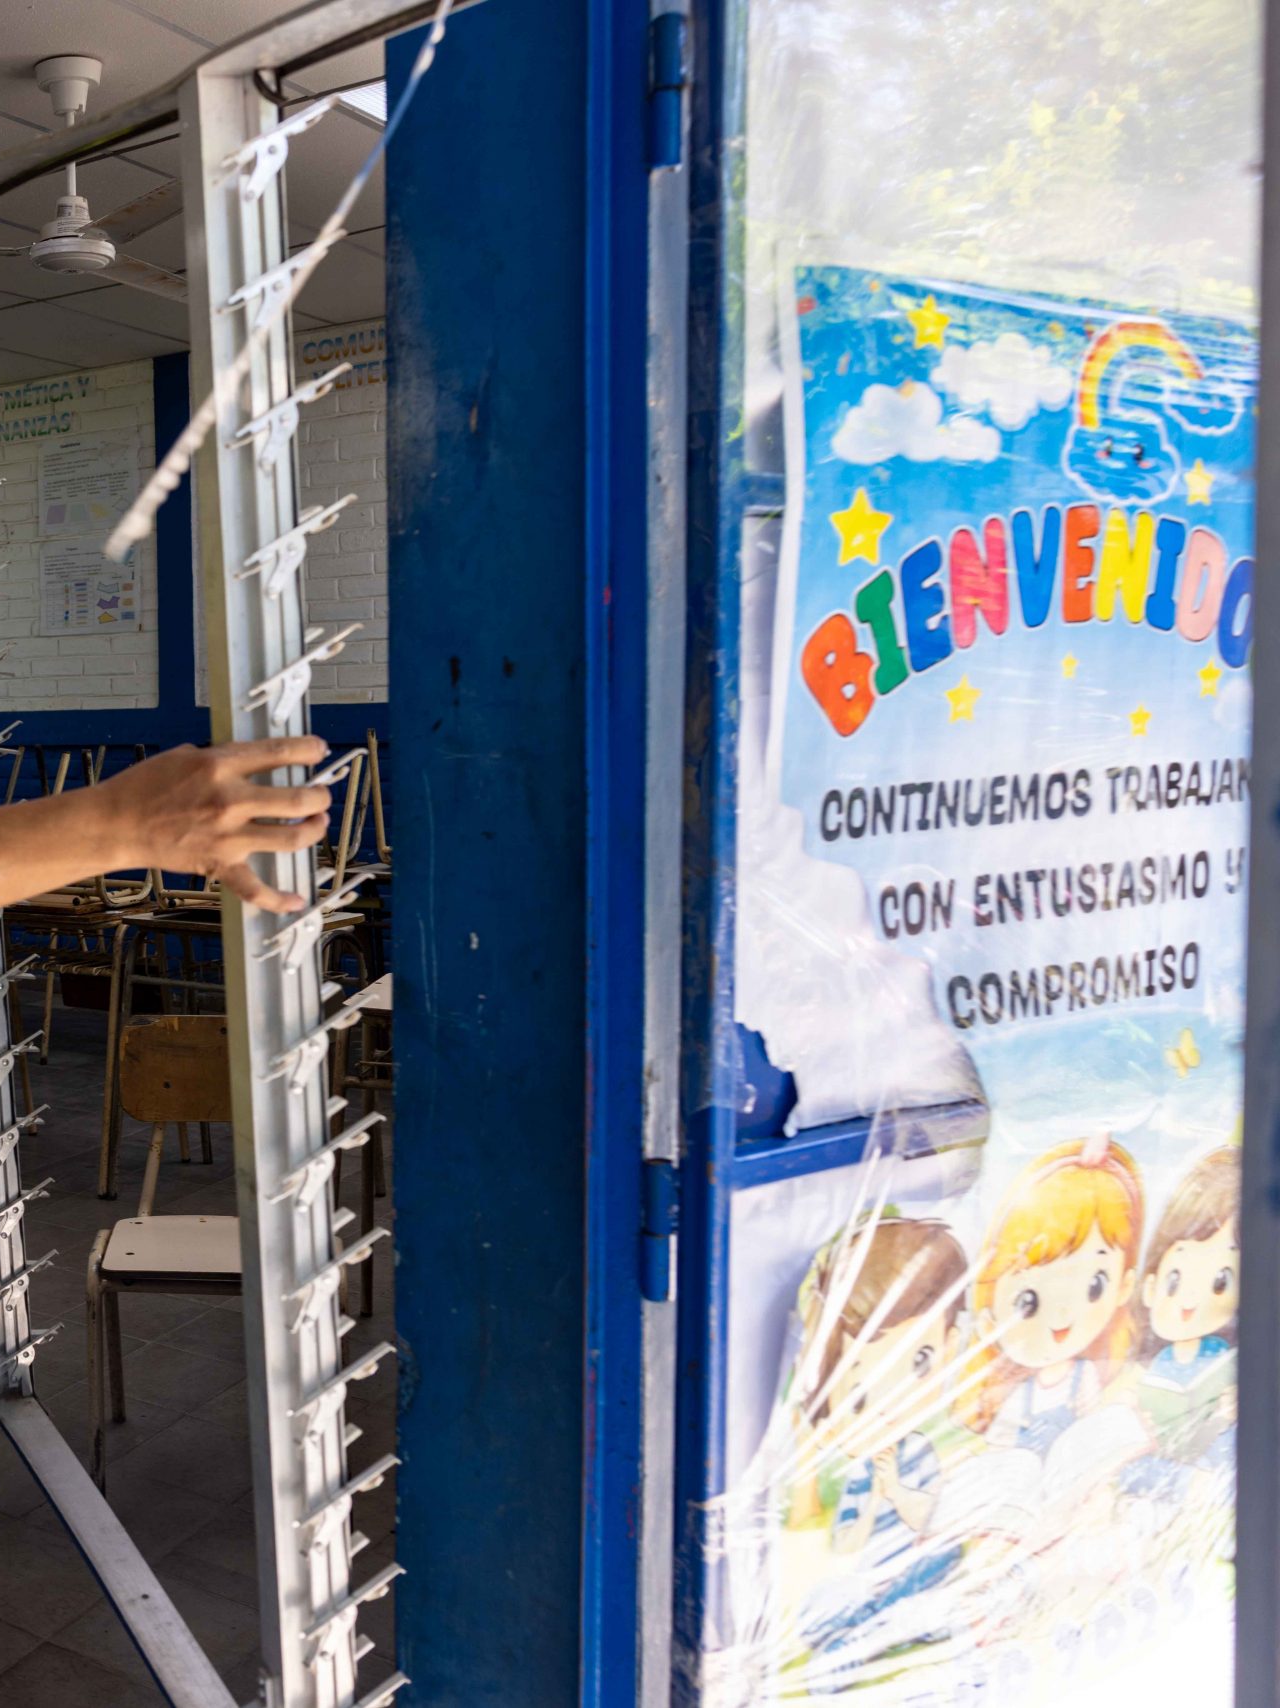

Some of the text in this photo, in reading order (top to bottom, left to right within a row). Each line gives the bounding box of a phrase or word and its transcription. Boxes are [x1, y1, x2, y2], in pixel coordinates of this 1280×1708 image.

[77, 375, 90, 398] Y
[335, 361, 387, 389] LITE
[801, 504, 1255, 736] BIENVENIDO
[821, 768, 1092, 842] CONTINUEMOS
[879, 878, 955, 940] CON
[974, 850, 1210, 928] ENTUSIASMO
[947, 942, 1200, 1029] COMPROMISO
